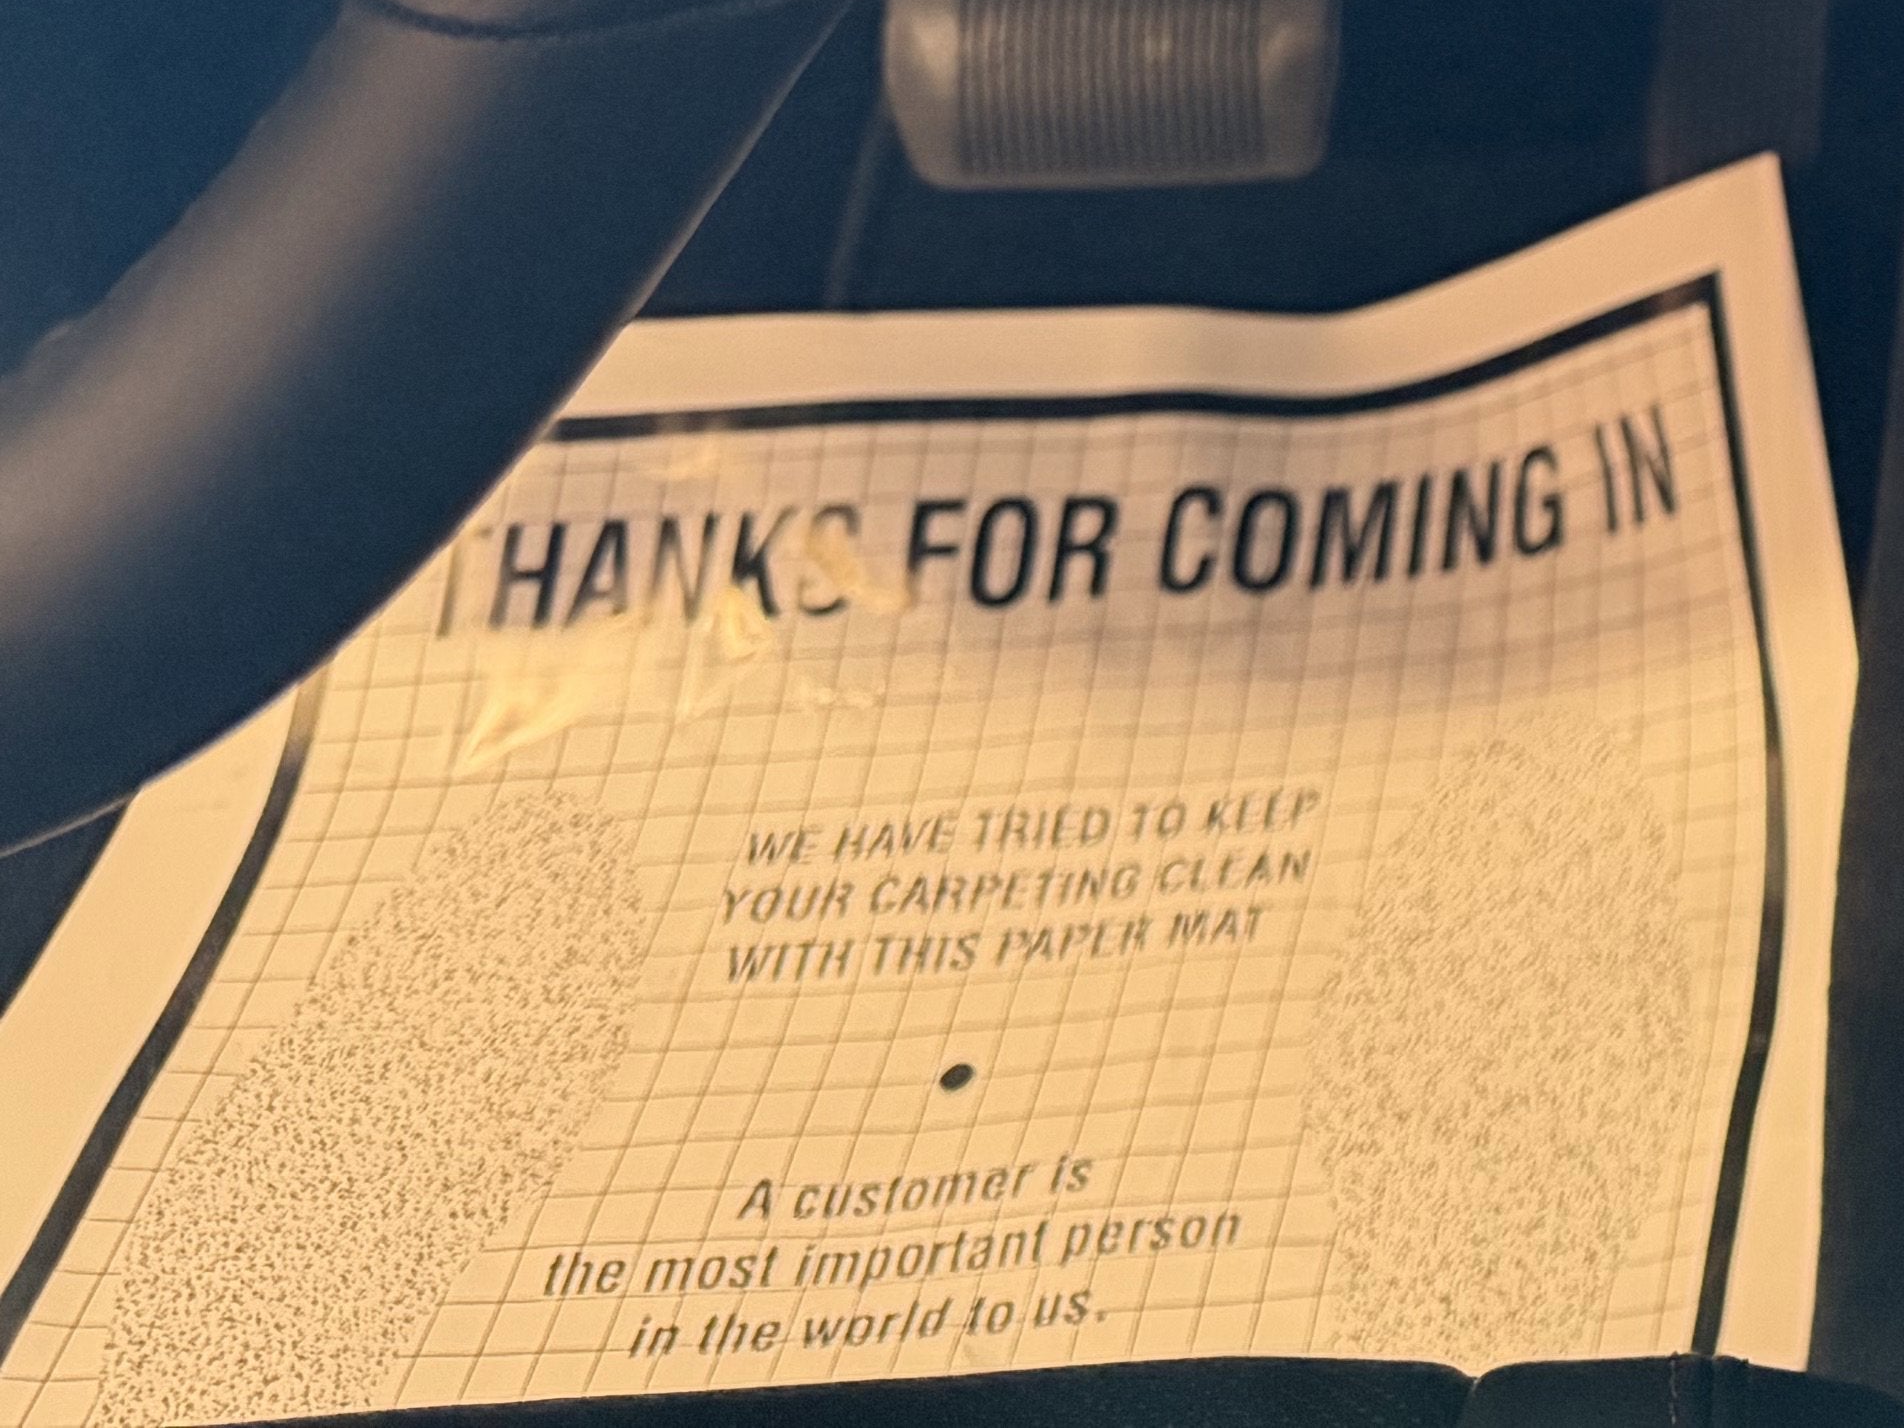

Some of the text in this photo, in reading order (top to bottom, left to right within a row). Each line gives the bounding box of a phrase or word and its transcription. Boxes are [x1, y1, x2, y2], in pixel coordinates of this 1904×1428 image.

[436, 403, 1680, 639] THANKS FOR COMING IN
[747, 785, 1322, 867] WE HAVE TRIED TO KEEP
[722, 846, 1312, 927] YOUR CARPETING CLEAN
[727, 903, 1266, 985] WITH THIS PAPER MAT
[736, 1149, 1095, 1222] A customer is
[543, 1209, 1243, 1297] the most important person
[628, 1288, 1110, 1359] in the world to us.
